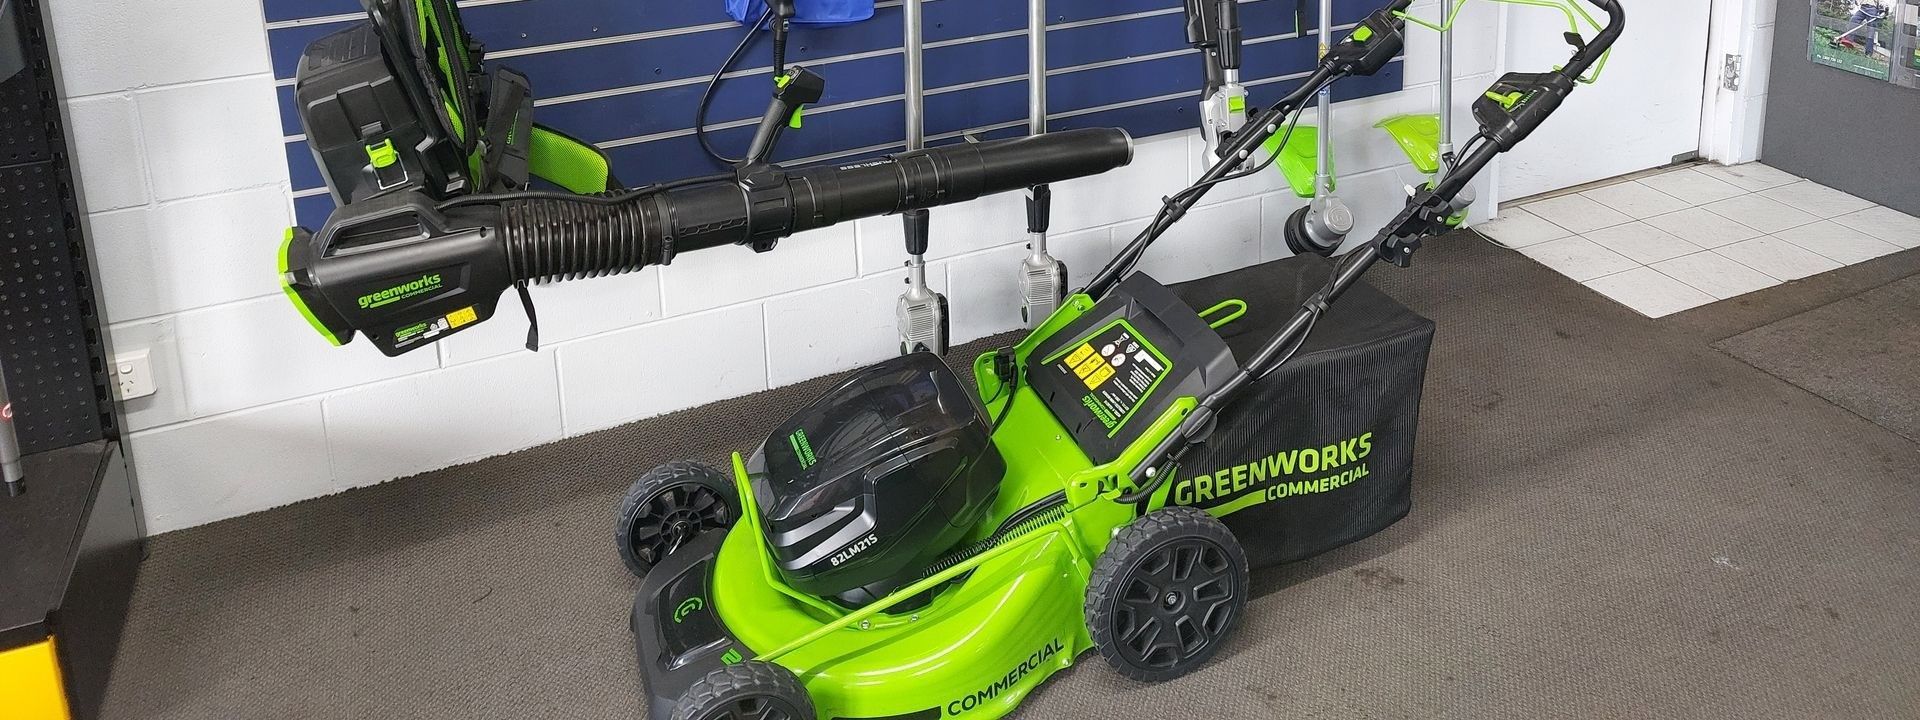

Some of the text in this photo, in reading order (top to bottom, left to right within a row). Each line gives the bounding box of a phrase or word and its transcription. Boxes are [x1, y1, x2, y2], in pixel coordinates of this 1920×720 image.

[358, 273, 441, 309] greenworks
[401, 283, 443, 300] COMMERCIAL
[1081, 394, 1118, 429] greenworks
[795, 428, 817, 466] GREENWORKS
[1175, 432, 1373, 506] GREENWORKS
[1267, 463, 1370, 501] COMMERCIAL
[830, 533, 879, 566] 82LM21S
[948, 638, 1065, 717] COMMERCIAL
